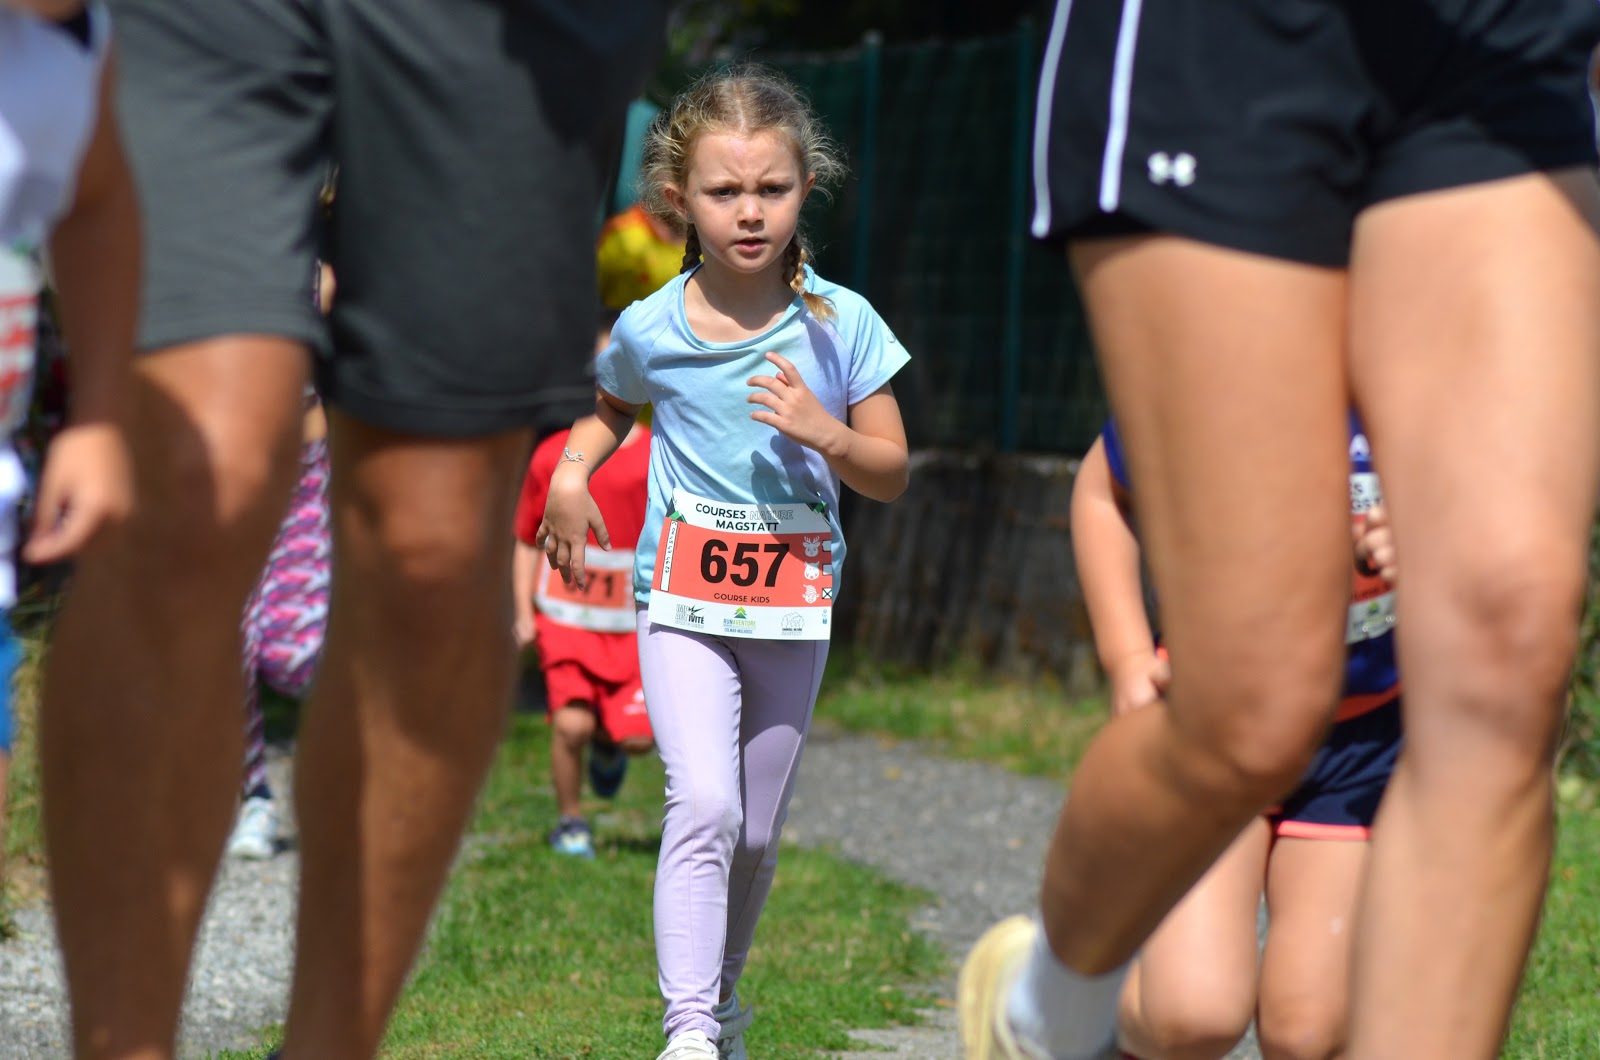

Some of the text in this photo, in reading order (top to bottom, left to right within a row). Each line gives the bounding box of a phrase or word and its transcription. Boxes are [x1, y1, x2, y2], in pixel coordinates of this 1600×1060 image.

[695, 503, 793, 521] COURSES NATURE
[715, 519, 779, 532] MAGSTATT
[700, 539, 790, 588] 657
[563, 569, 614, 598] 71
[713, 592, 770, 604] COURSE KIDS
